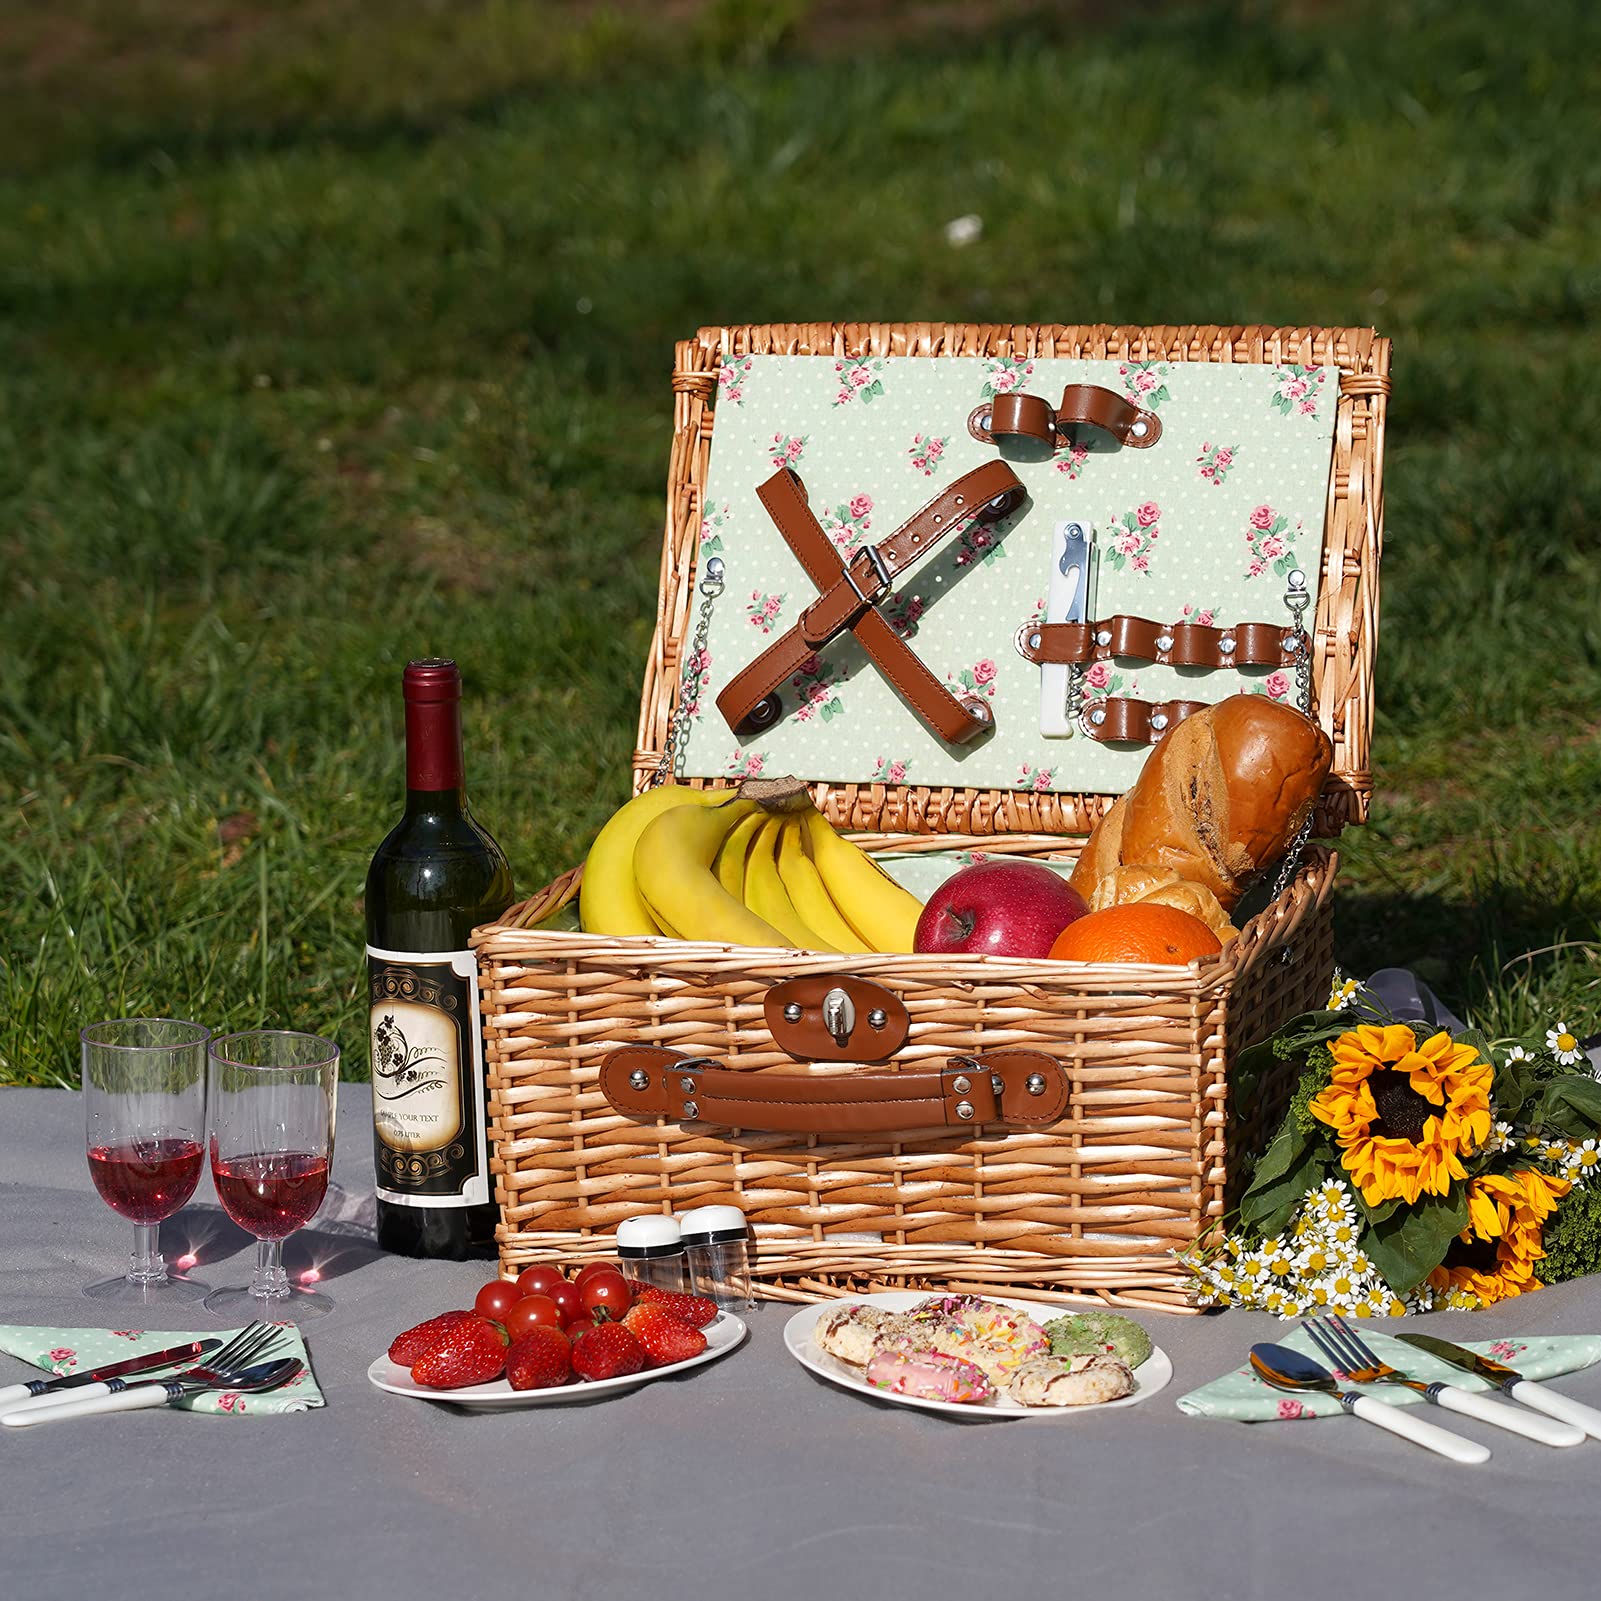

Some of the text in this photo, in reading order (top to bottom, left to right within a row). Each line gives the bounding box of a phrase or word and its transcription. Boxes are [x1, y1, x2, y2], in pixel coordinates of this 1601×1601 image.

[398, 1112, 419, 1122] YOUR
[419, 1114, 439, 1122] TEXT
[404, 1131, 421, 1139] LITER
